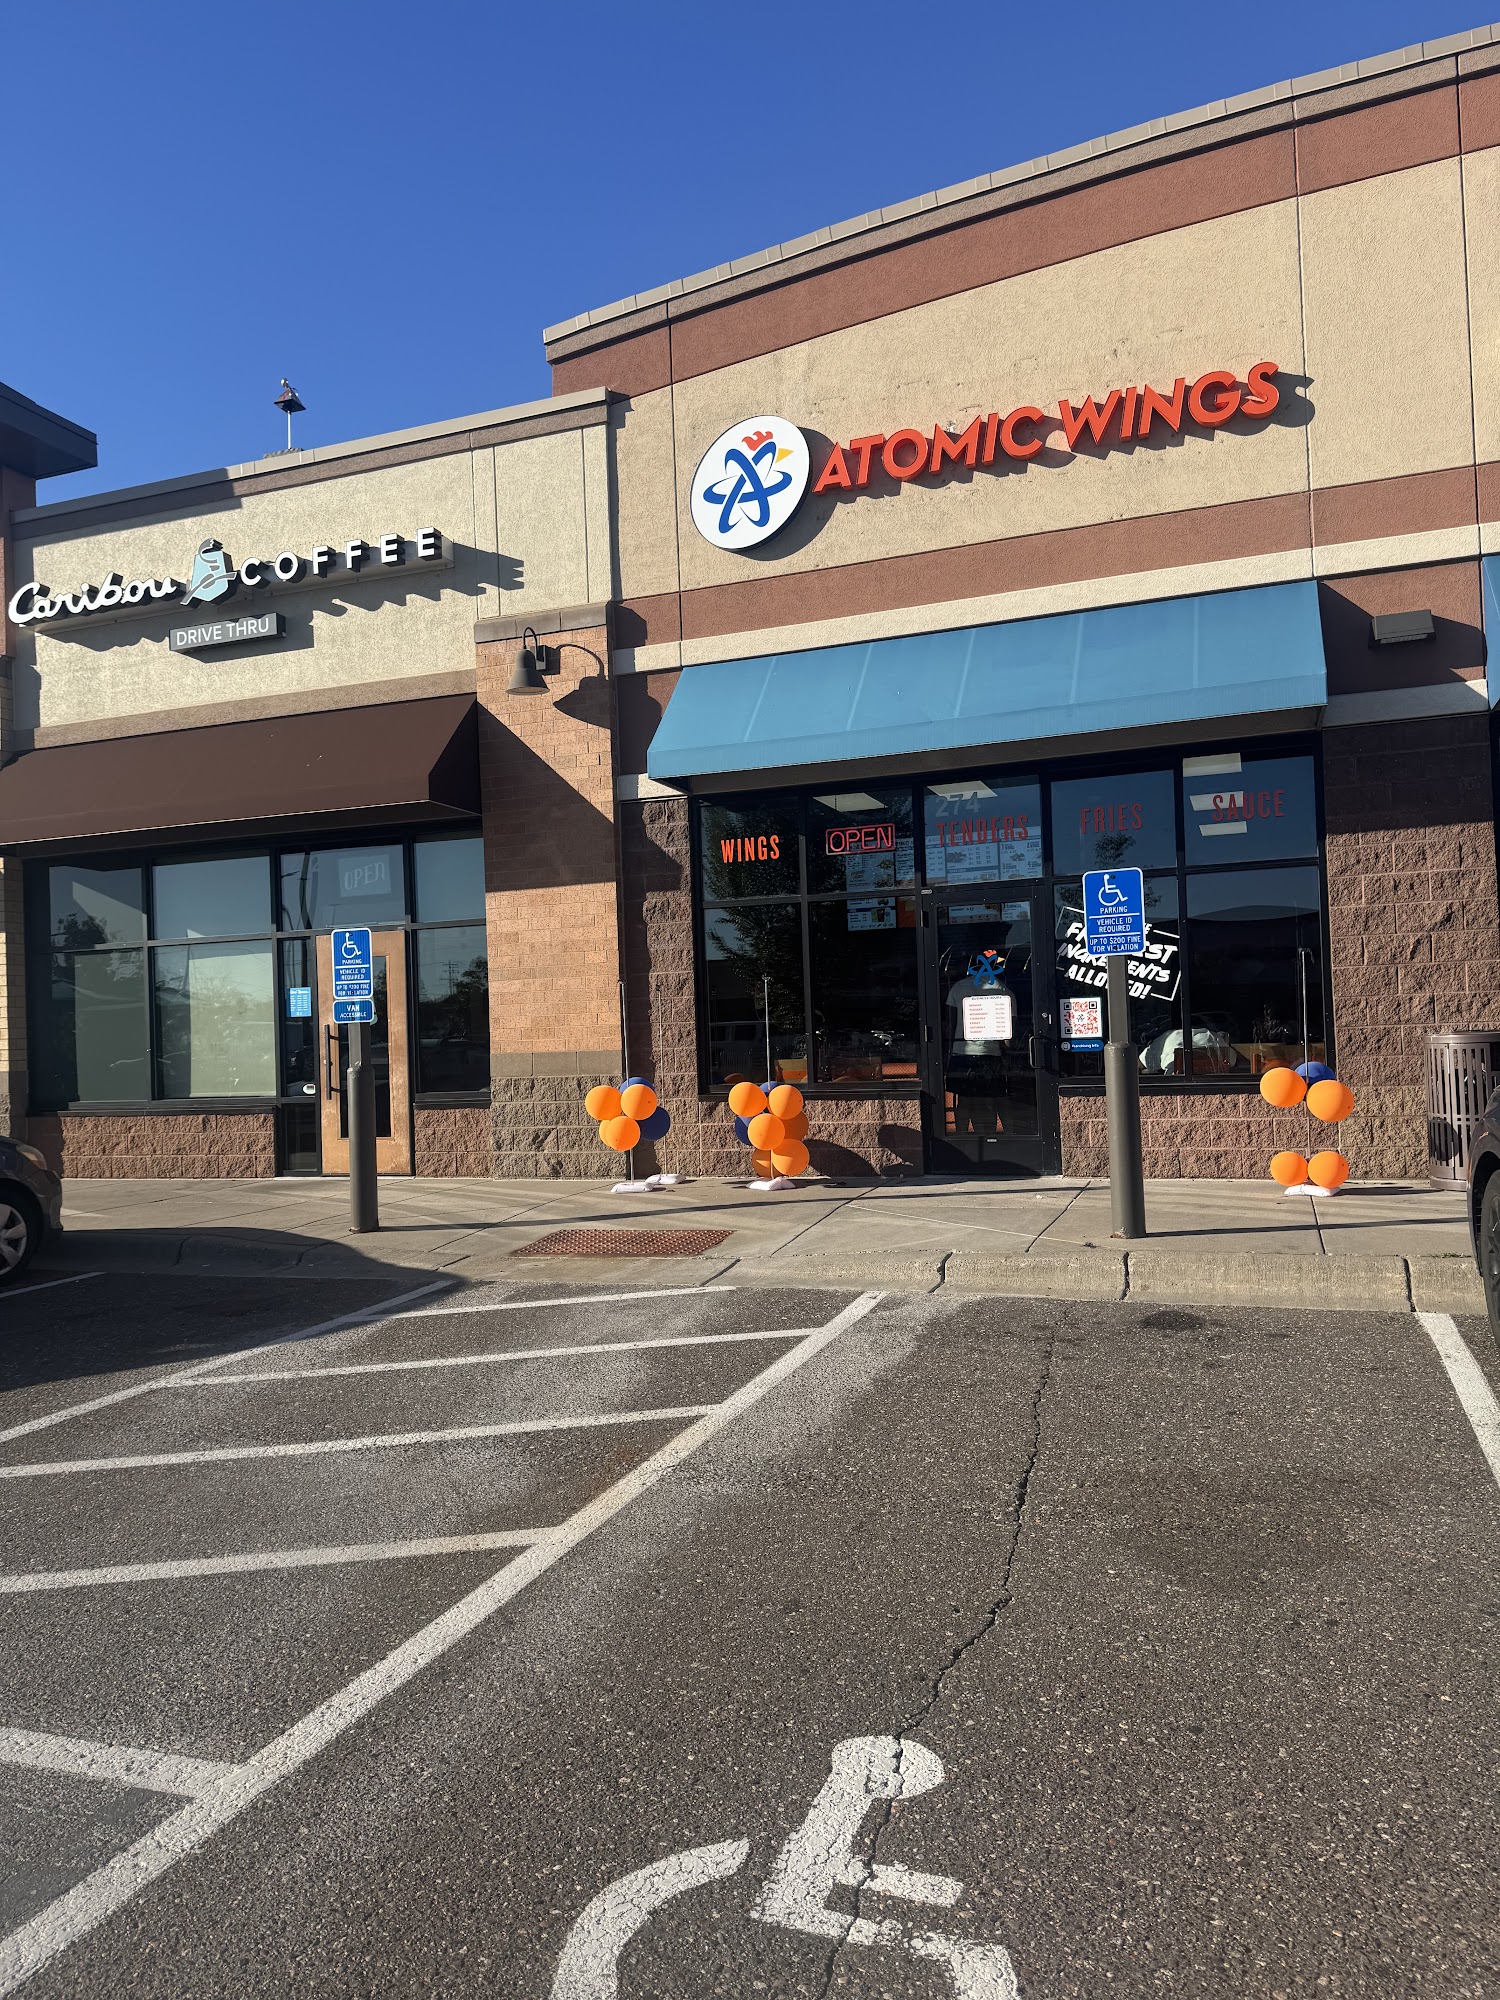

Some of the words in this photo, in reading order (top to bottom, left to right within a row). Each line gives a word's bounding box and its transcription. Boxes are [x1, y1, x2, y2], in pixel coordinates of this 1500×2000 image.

[812, 405, 1045, 496] ATOMIC
[1058, 361, 1281, 451] WINGS
[8, 571, 176, 624] Caribou
[241, 526, 435, 586] COFFEE
[177, 625, 222, 646] DRIVE
[226, 617, 269, 638] THRU
[936, 791, 980, 818] 274
[1212, 790, 1285, 822] SAUCE
[936, 815, 1029, 848] TENDERS
[1081, 803, 1144, 834] FRIES
[720, 834, 780, 864] WINGS
[828, 825, 893, 852] OPEN
[344, 862, 385, 890] OPEN
[1097, 917, 1123, 926] VEHICLE
[1126, 916, 1132, 924] ID
[1100, 906, 1128, 914] PARKING
[1090, 938, 1098, 946] UP
[1100, 937, 1107, 945] TO
[1109, 936, 1126, 945] $200
[1127, 935, 1141, 944] FINE
[1099, 924, 1131, 933] REQUIRED
[1093, 945, 1105, 953] FOR
[346, 1004, 360, 1012] VAN
